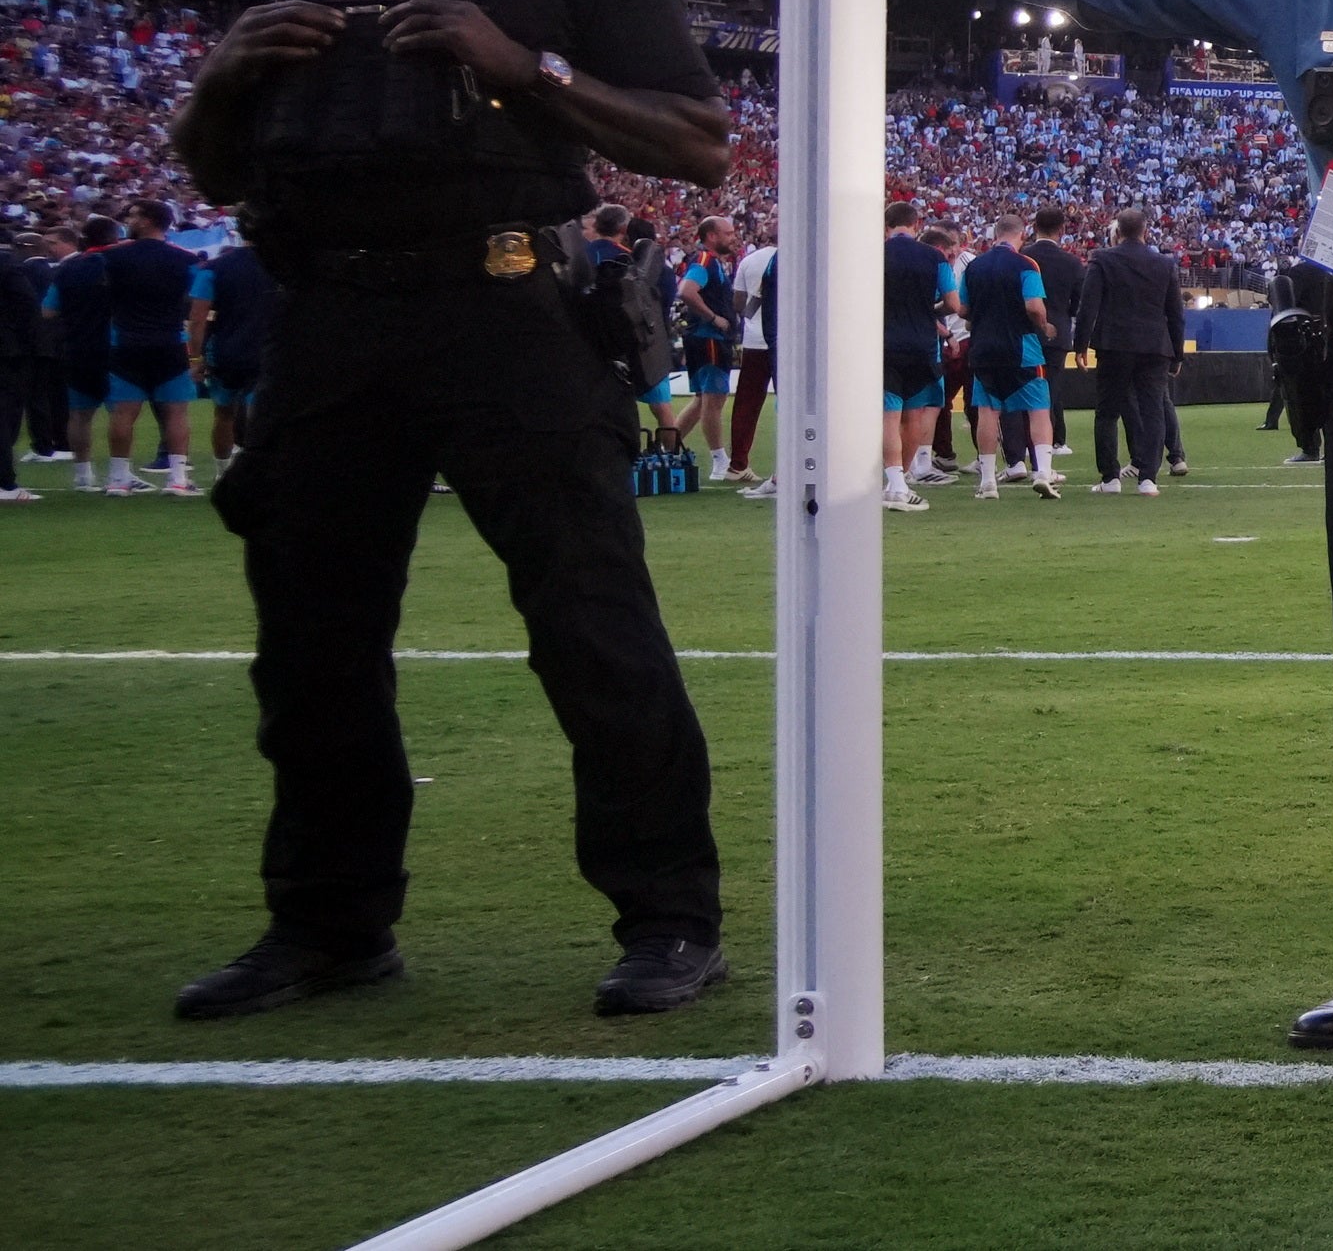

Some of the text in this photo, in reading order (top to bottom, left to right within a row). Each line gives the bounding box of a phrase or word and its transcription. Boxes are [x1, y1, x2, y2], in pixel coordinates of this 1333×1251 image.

[1169, 87, 1192, 97] FIFA
[1193, 88, 1231, 98] WORLD
[1255, 91, 1283, 100] 202
